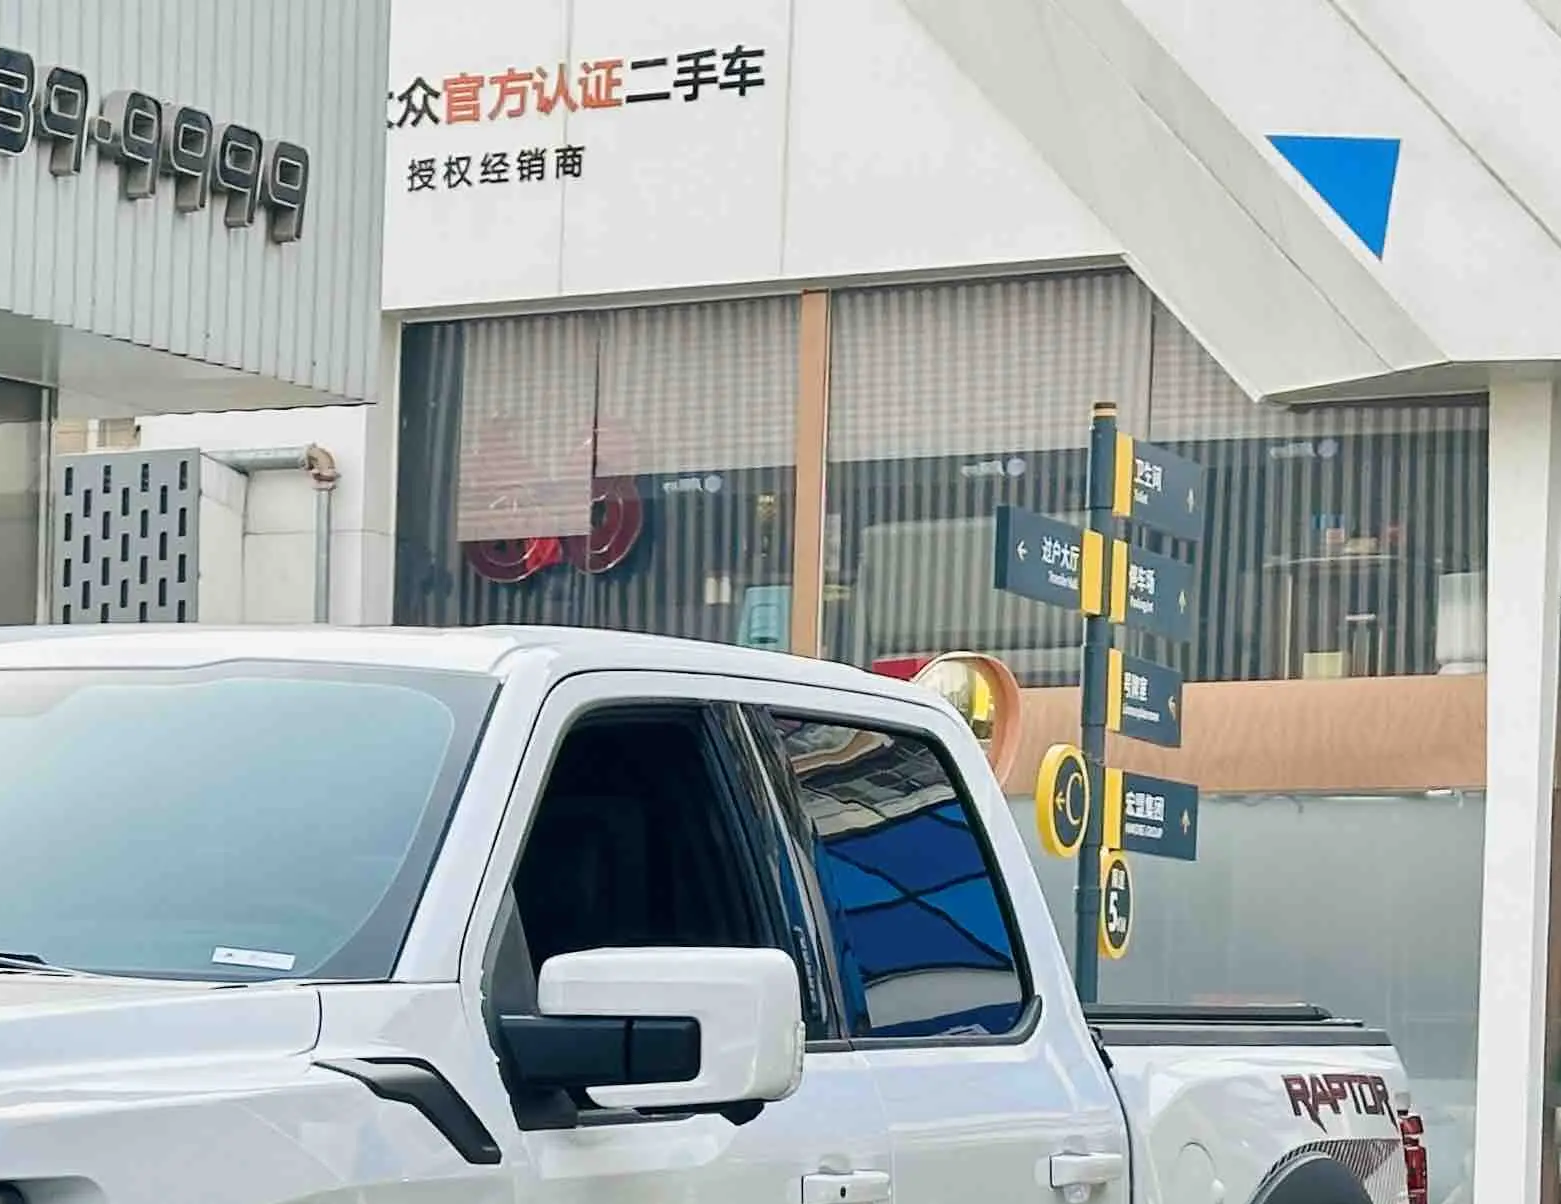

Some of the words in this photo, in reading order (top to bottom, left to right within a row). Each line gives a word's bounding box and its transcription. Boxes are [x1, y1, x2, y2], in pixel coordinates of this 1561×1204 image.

[387, 44, 766, 130] 众官方认证二手车
[406, 144, 586, 192] 授权经销商
[1281, 1074, 1399, 1134] RAPTOR
